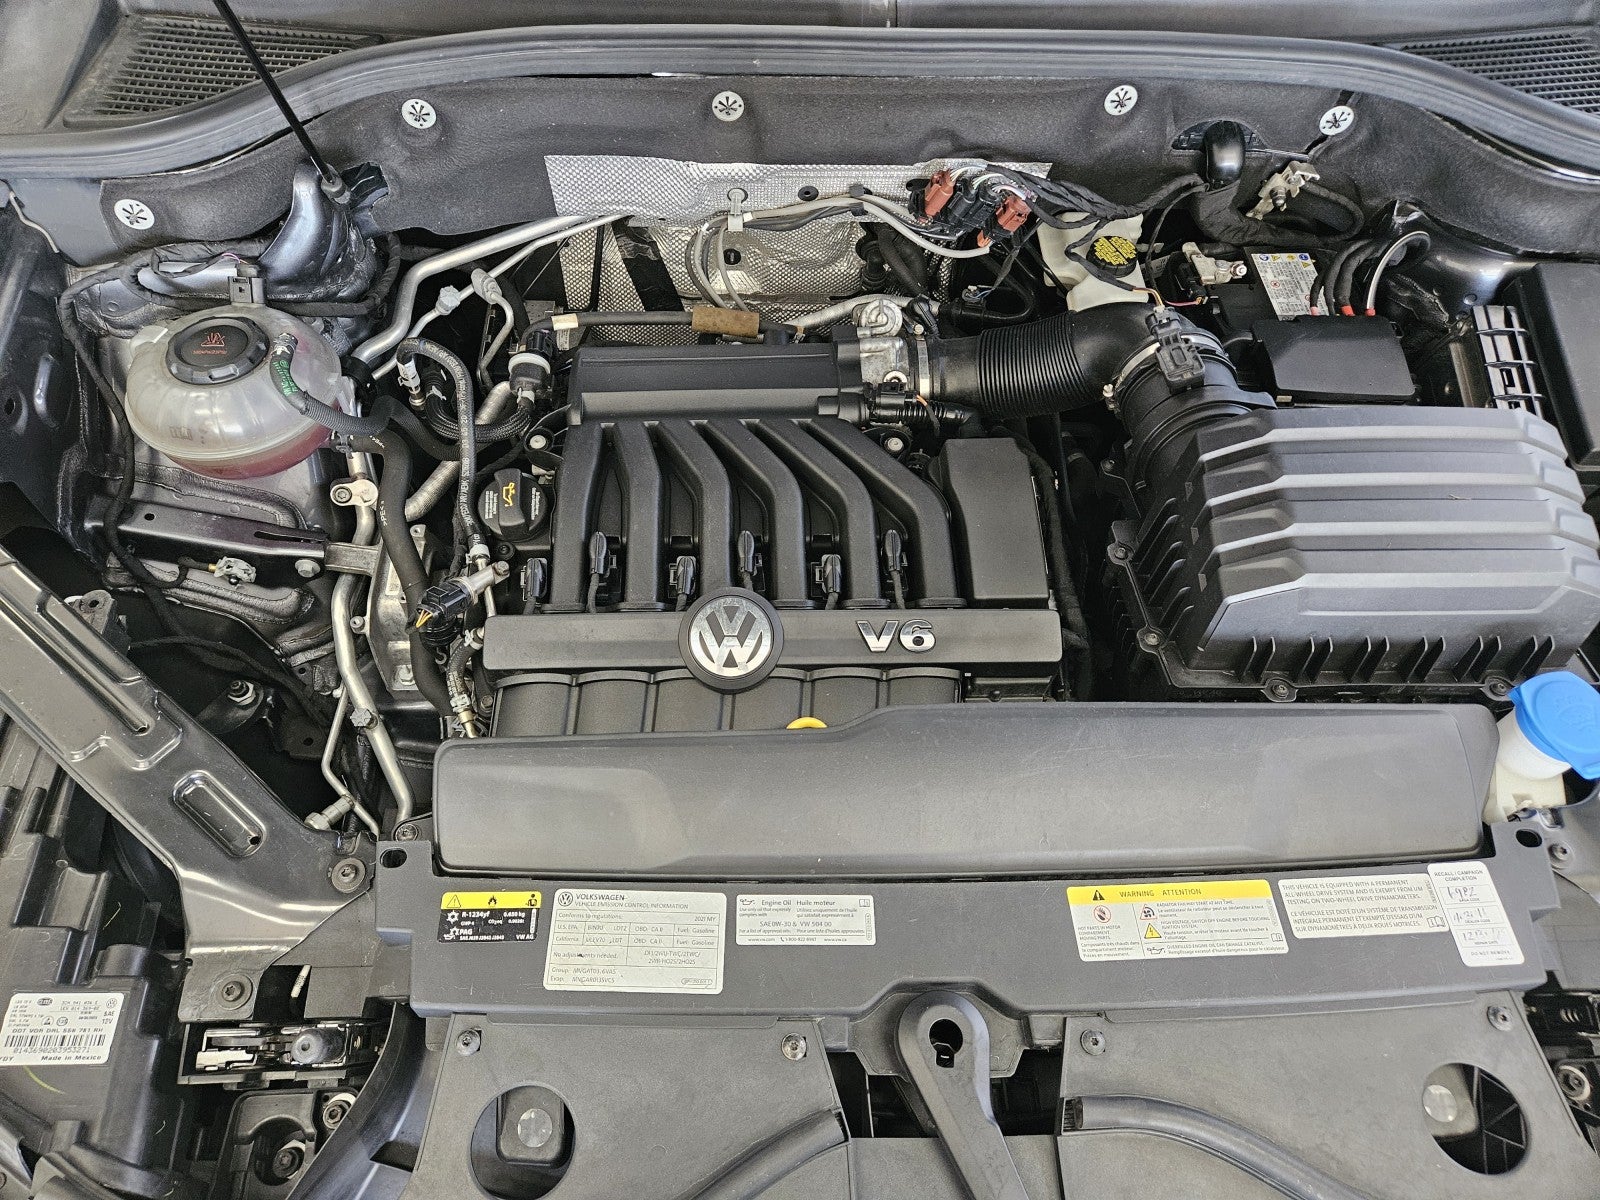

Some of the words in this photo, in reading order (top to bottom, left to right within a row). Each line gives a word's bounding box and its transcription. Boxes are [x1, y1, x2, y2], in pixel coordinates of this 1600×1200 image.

[856, 618, 936, 653] V6
[575, 893, 625, 902] VOLKSWAGEN
[1119, 889, 1155, 898] WARNING
[1162, 888, 1202, 896] ATTENTION
